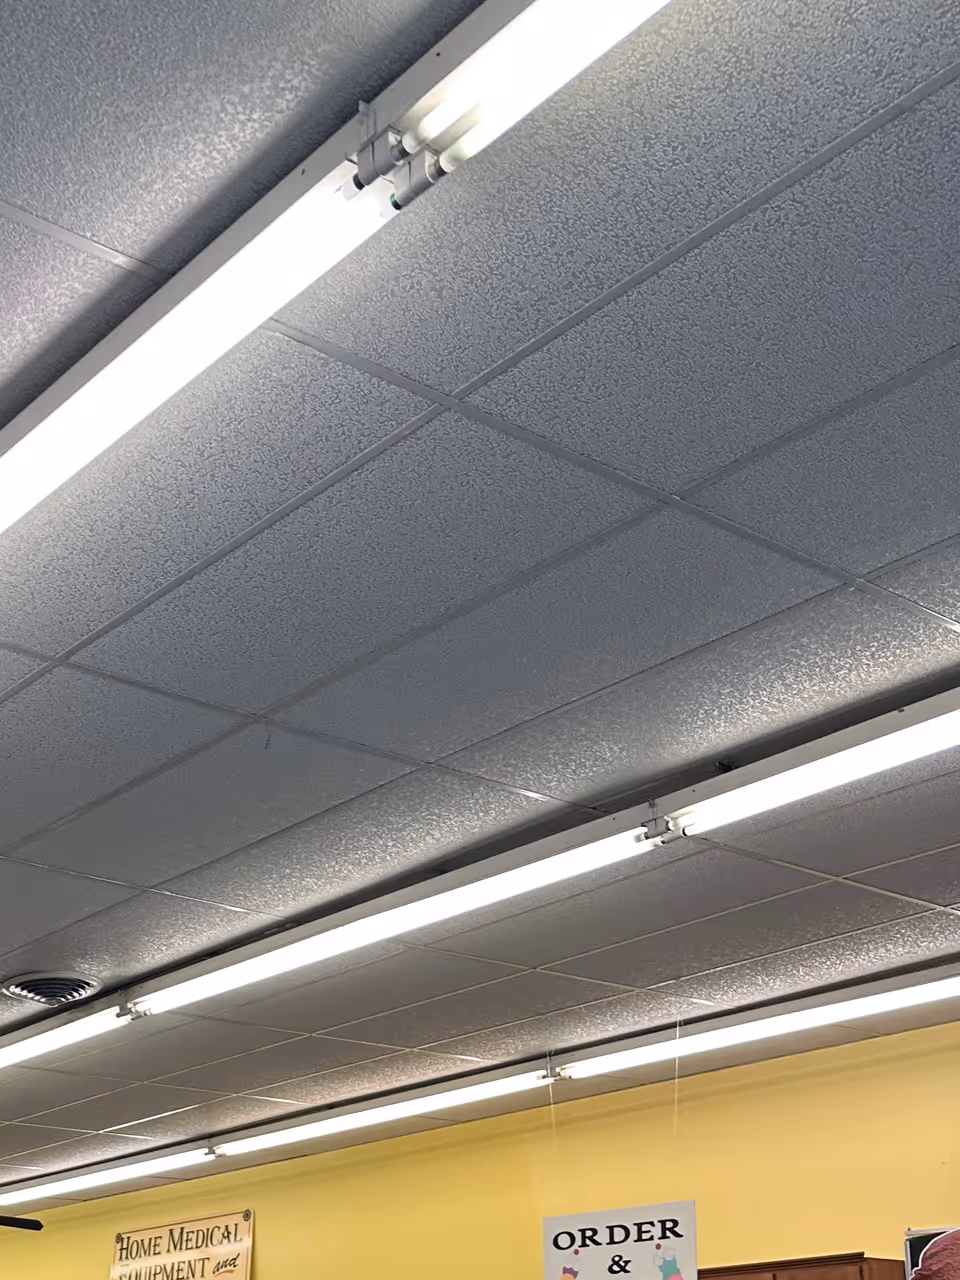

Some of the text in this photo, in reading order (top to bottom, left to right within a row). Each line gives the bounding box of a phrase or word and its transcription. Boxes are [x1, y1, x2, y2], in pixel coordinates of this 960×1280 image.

[118, 1223, 243, 1261] HOME MEDICAL
[552, 1218, 683, 1251] ORDER
[212, 1253, 241, 1275] and
[607, 1254, 632, 1275] &
